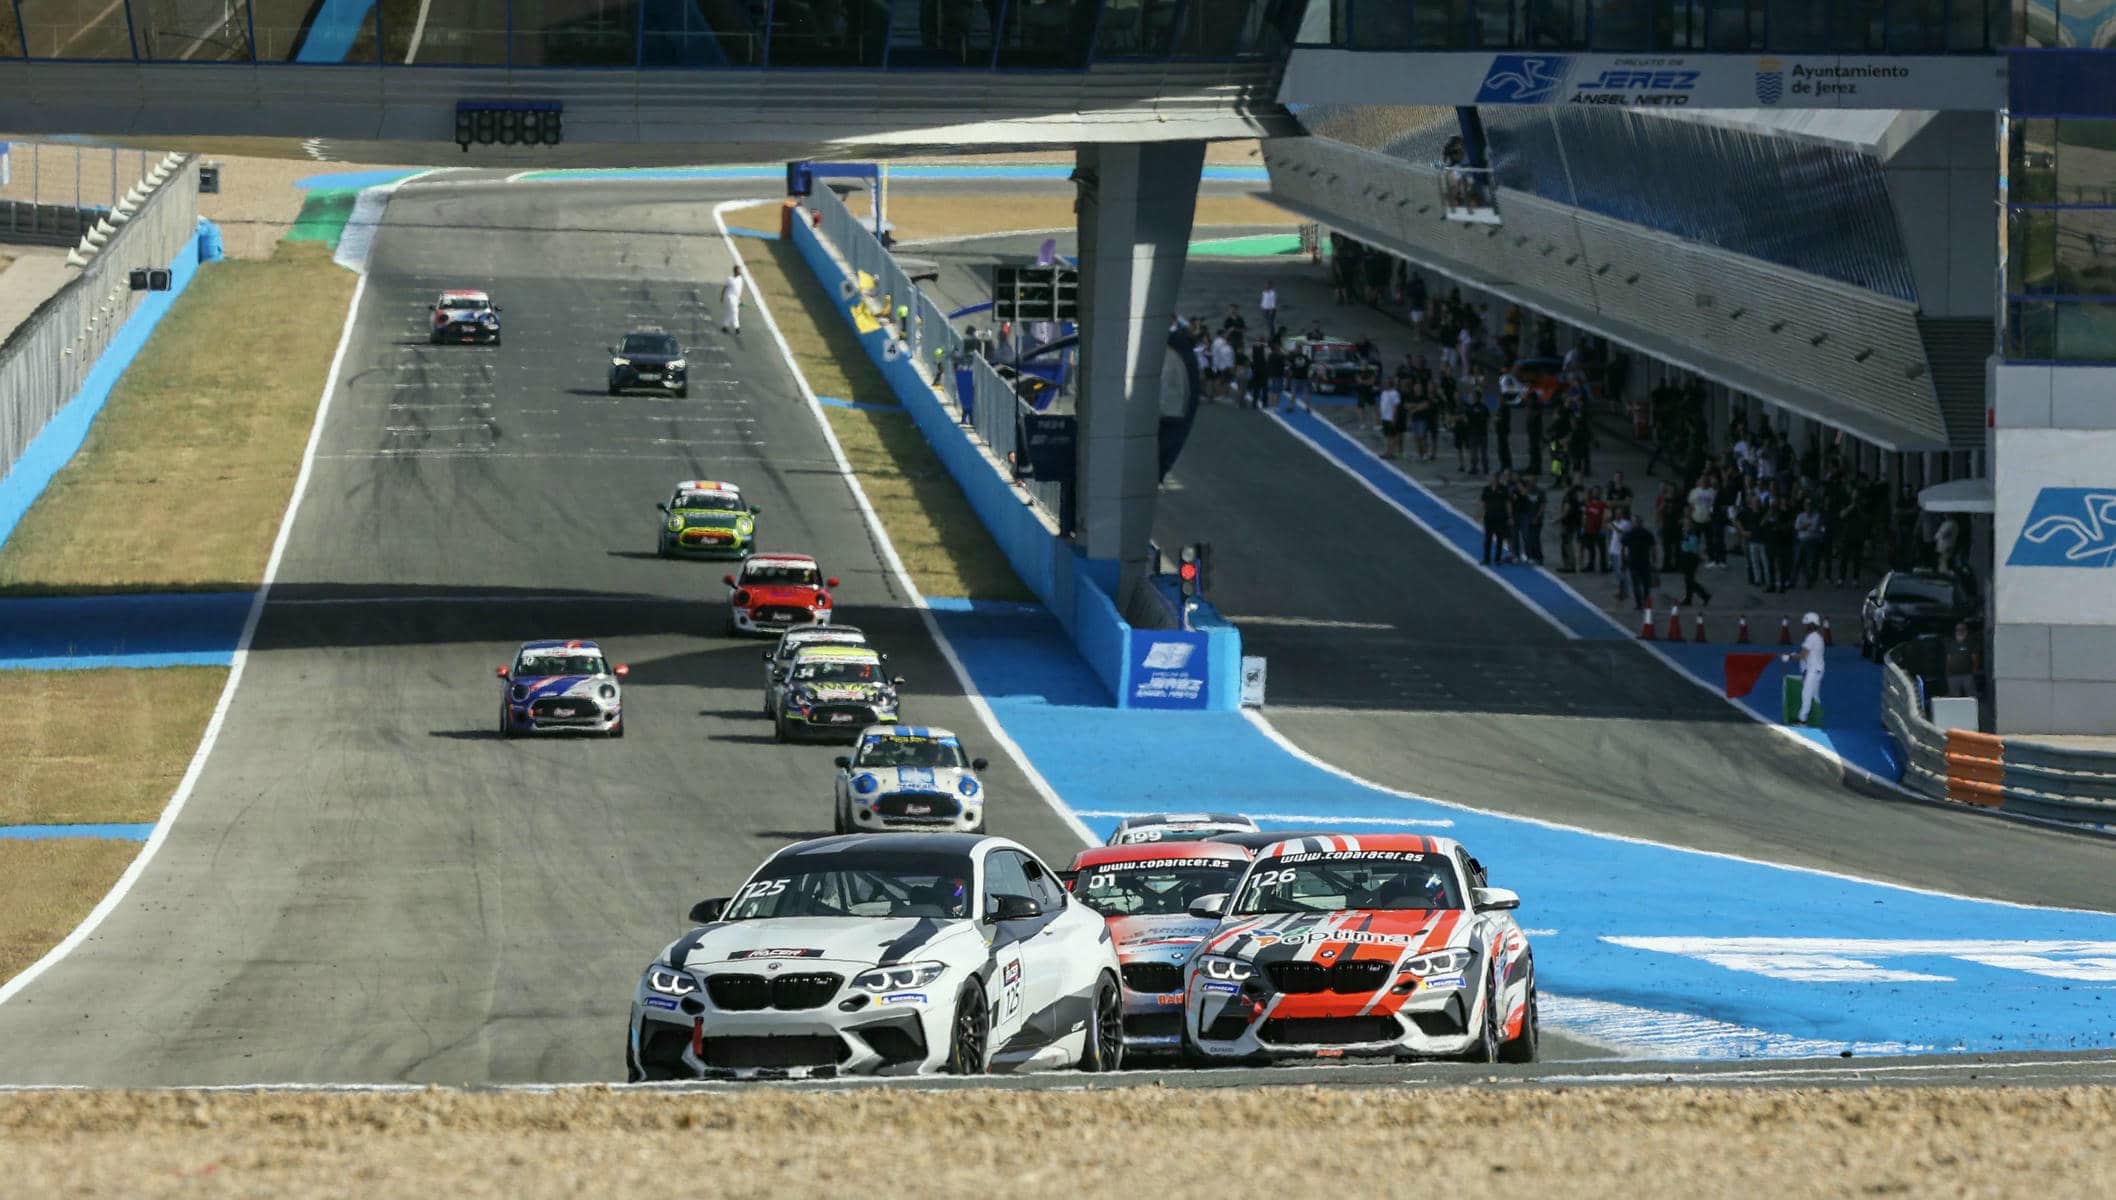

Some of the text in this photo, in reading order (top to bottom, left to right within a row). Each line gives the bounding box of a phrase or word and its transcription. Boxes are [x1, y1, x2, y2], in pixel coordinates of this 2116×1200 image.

[1577, 71, 1700, 90] JEREZ
[1792, 64, 1909, 80] Ayuntamiento
[1792, 81, 1857, 97] de Jerez
[1569, 91, 1689, 105] ÁNGEL NIETO
[1279, 850, 1425, 864] www.coparacer.es
[1098, 858, 1231, 874] www.coparacer.es
[1250, 867, 1297, 889] 126
[746, 878, 791, 900] 125
[1284, 928, 1411, 946] optima
[1005, 982, 1020, 1018] 125
